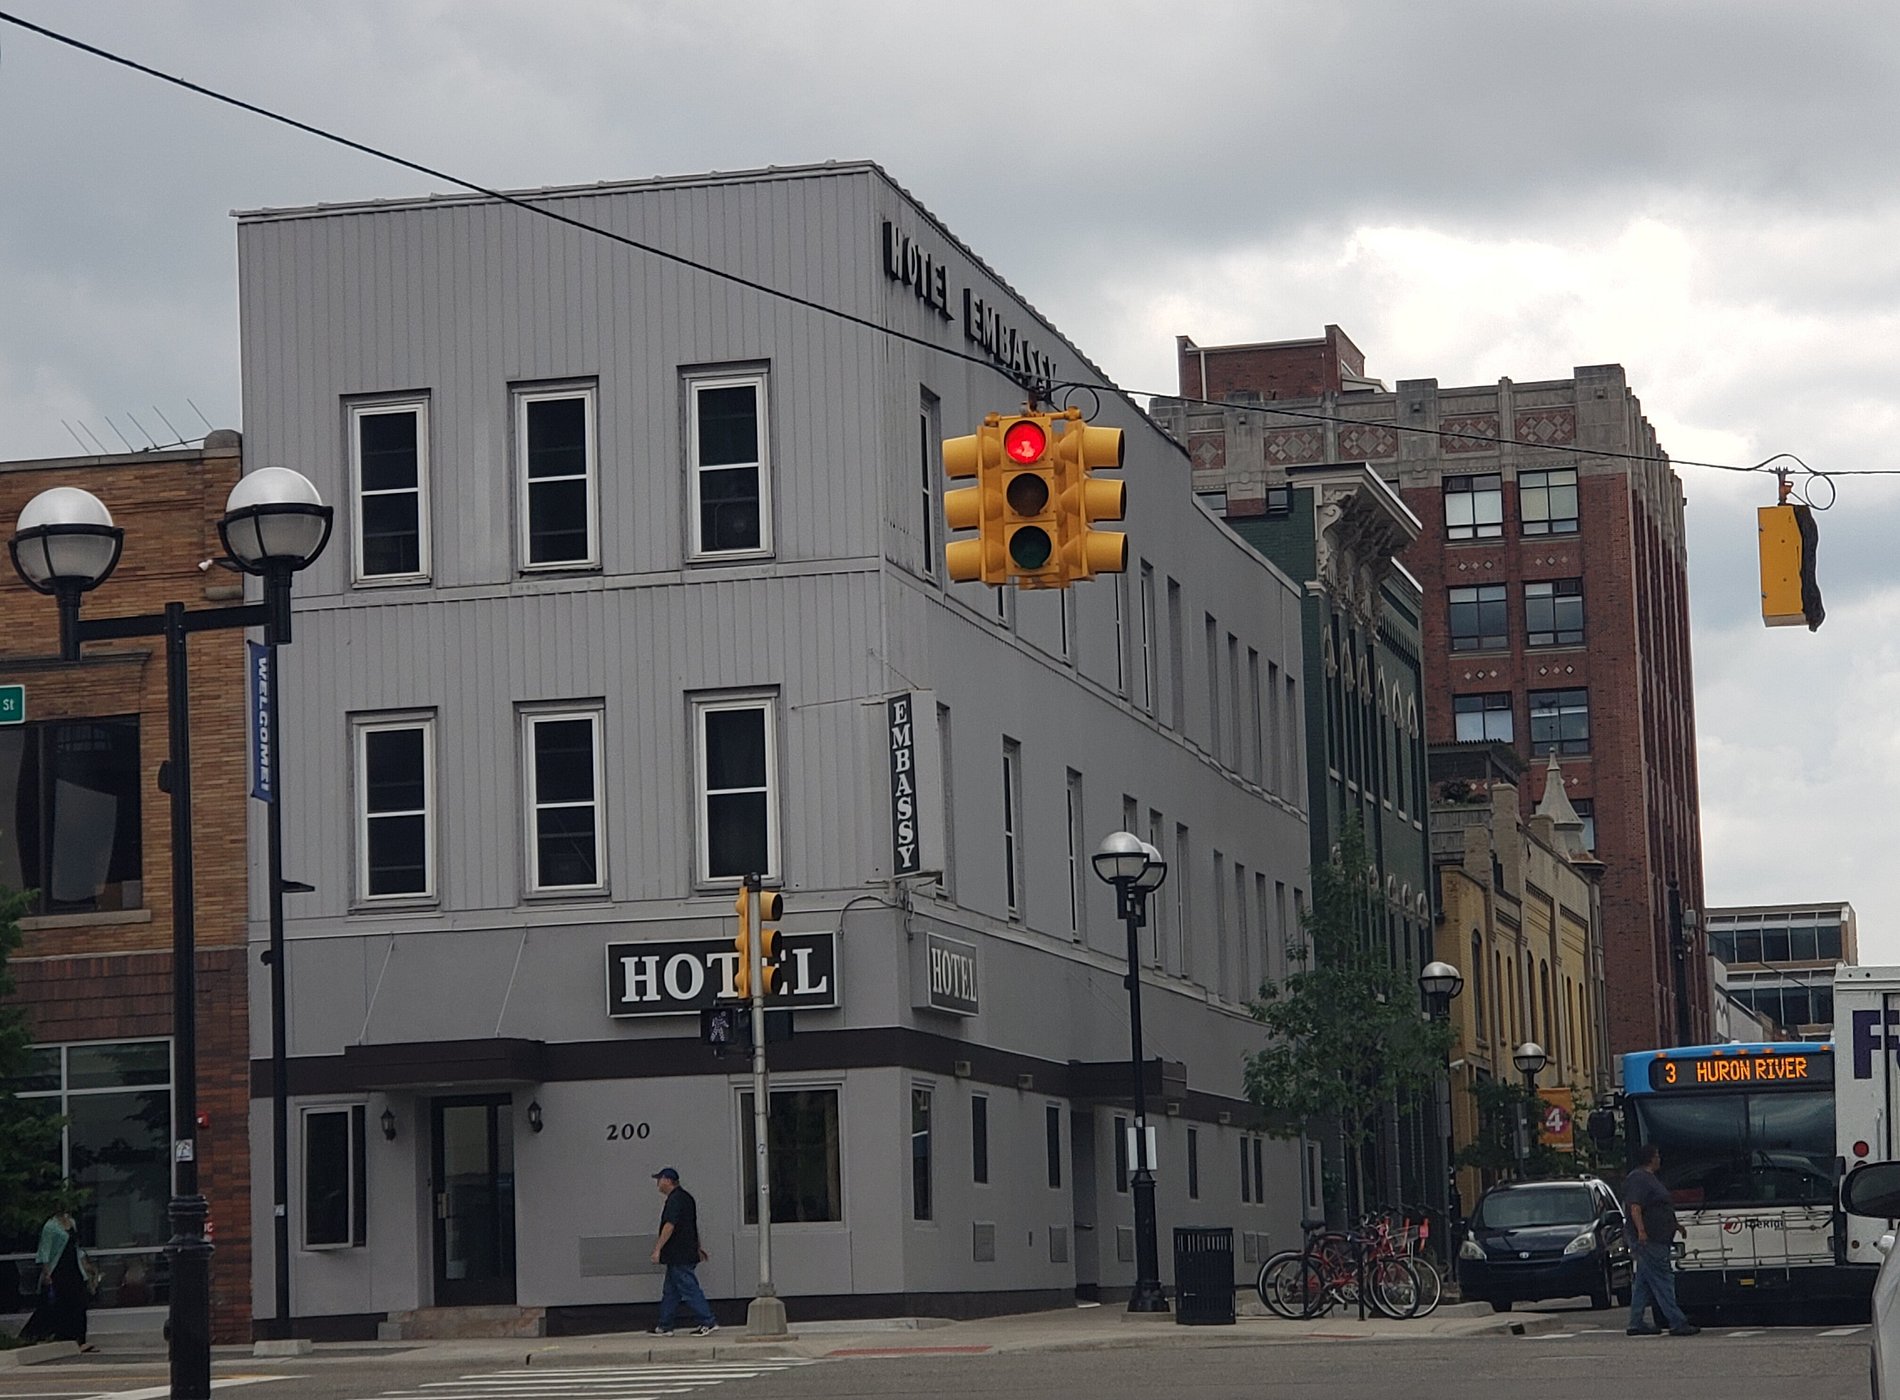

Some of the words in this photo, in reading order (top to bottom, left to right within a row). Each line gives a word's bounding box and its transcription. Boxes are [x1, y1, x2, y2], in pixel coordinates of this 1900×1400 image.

[883, 221, 955, 321] HOTEL
[963, 288, 1056, 398] EMBASSY
[3, 698, 15, 711] St
[258, 657, 270, 792] WELCOME!
[892, 700, 916, 868] EMBASSY
[931, 947, 977, 1002] HOTEL
[1665, 1062, 1677, 1084] 3
[1696, 1060, 1750, 1082] HURON
[1755, 1057, 1808, 1080] RIVER
[607, 1122, 650, 1141] 200
[1546, 1108, 1563, 1132] 4
